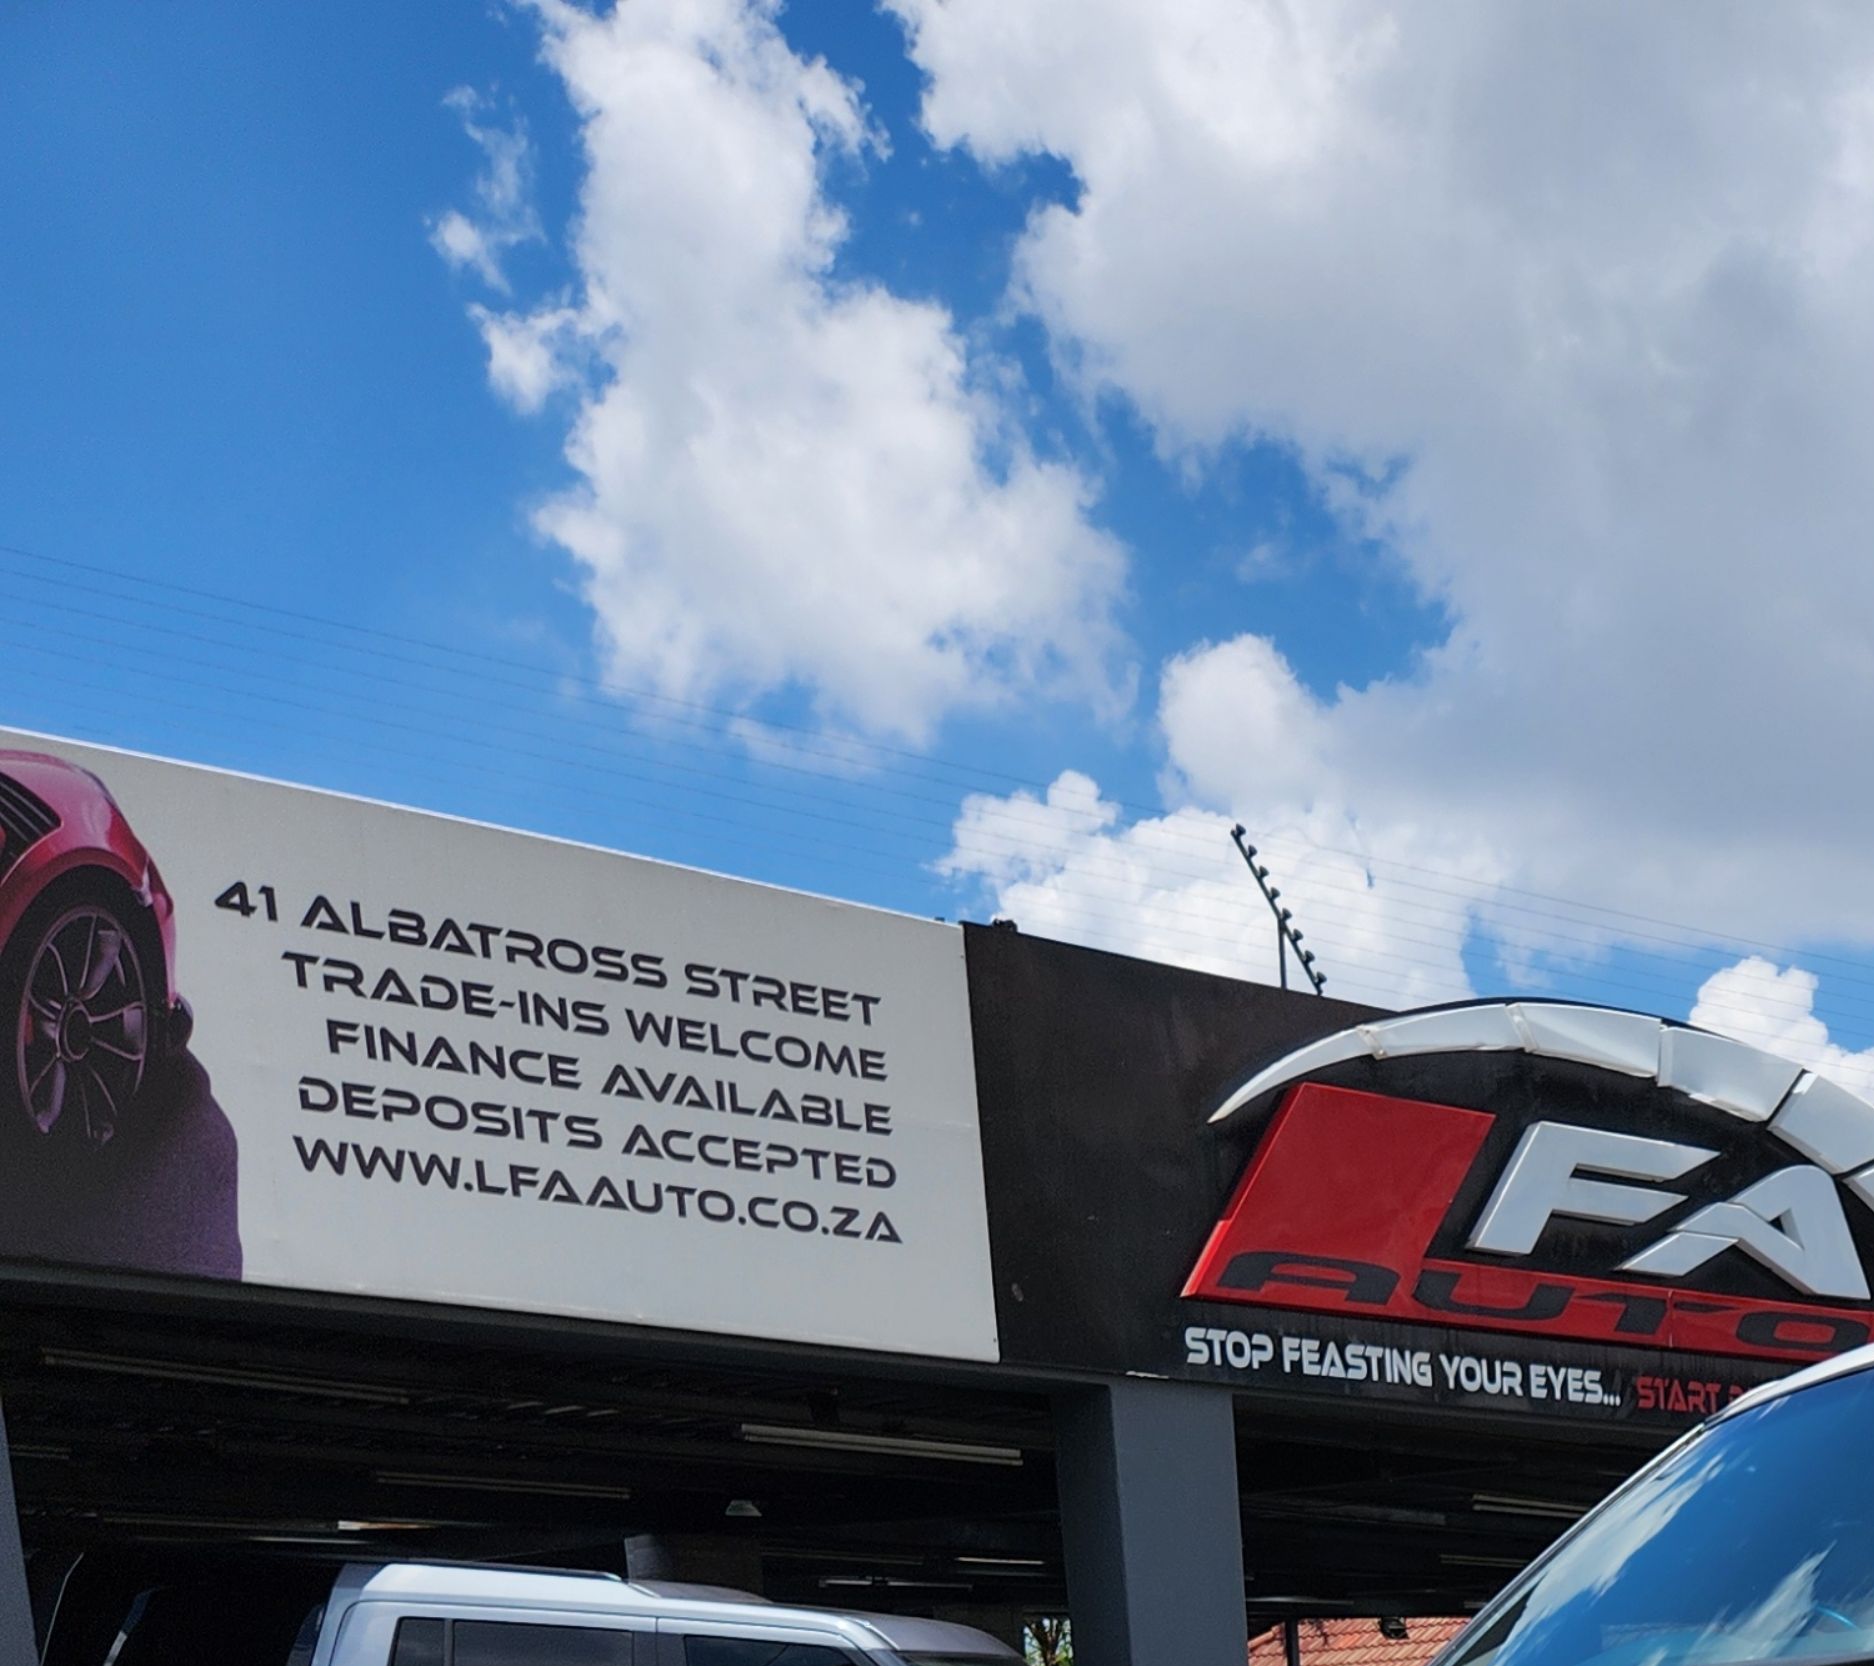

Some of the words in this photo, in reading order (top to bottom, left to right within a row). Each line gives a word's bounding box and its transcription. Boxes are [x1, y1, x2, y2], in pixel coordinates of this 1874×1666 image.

[214, 881, 278, 922] 41
[300, 895, 668, 989] ALBATROSS
[684, 963, 881, 1026] STREET
[281, 951, 610, 1037] TRADE-INS
[624, 1008, 888, 1082] WELCOME
[298, 1076, 603, 1150] DEPOSITS
[621, 1124, 897, 1189] ACCEPTED
[326, 1018, 582, 1090] FINANCE
[601, 1064, 893, 1136] AVAILABLE
[292, 1135, 902, 1244] WWW.LFAAUTO.CO.ZA
[1216, 1251, 1870, 1349] AUTO
[1185, 1327, 1273, 1369] STOP
[1282, 1337, 1433, 1387] FEASTING
[1439, 1354, 1523, 1396] YOUR
[1530, 1364, 1621, 1407] EYES...
[1636, 1376, 1721, 1413] START
